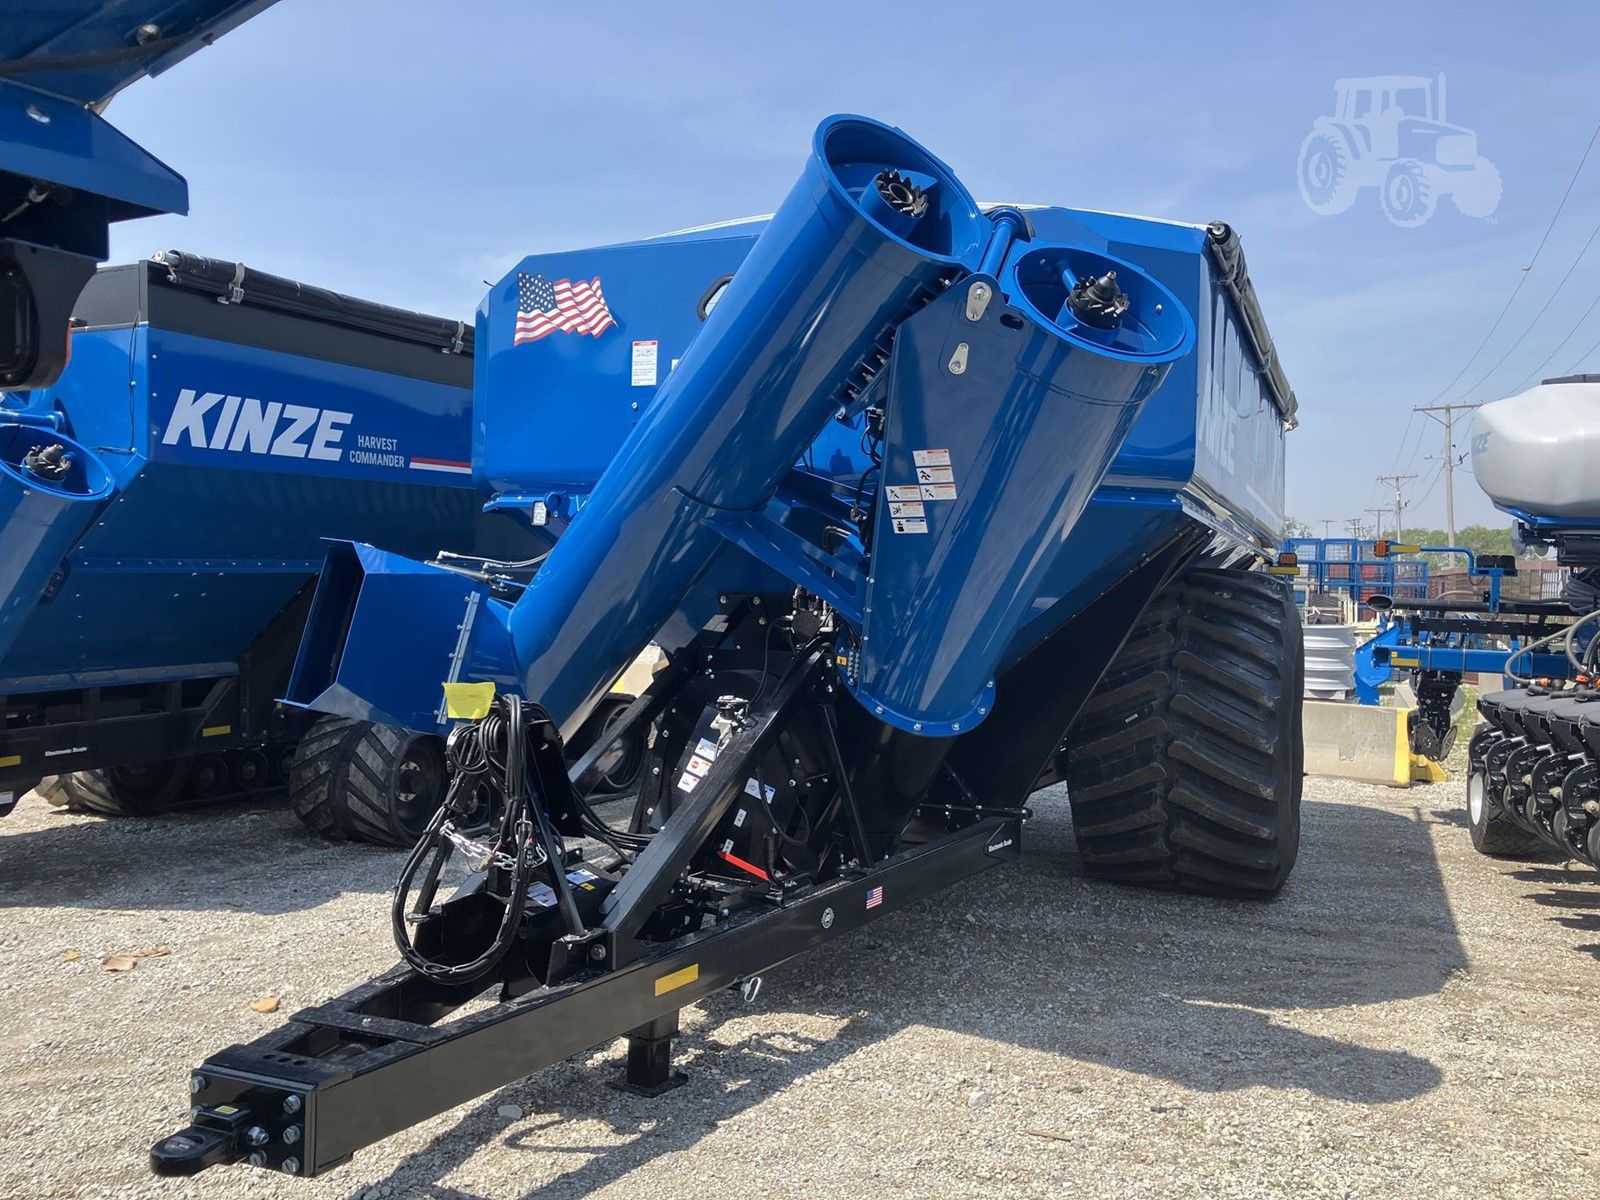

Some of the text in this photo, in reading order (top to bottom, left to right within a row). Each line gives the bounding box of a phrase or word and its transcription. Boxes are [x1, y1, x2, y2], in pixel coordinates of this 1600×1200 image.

[162, 388, 353, 462] KINZE
[358, 435, 397, 451] HARVEST
[350, 450, 405, 468] COMMANDER
